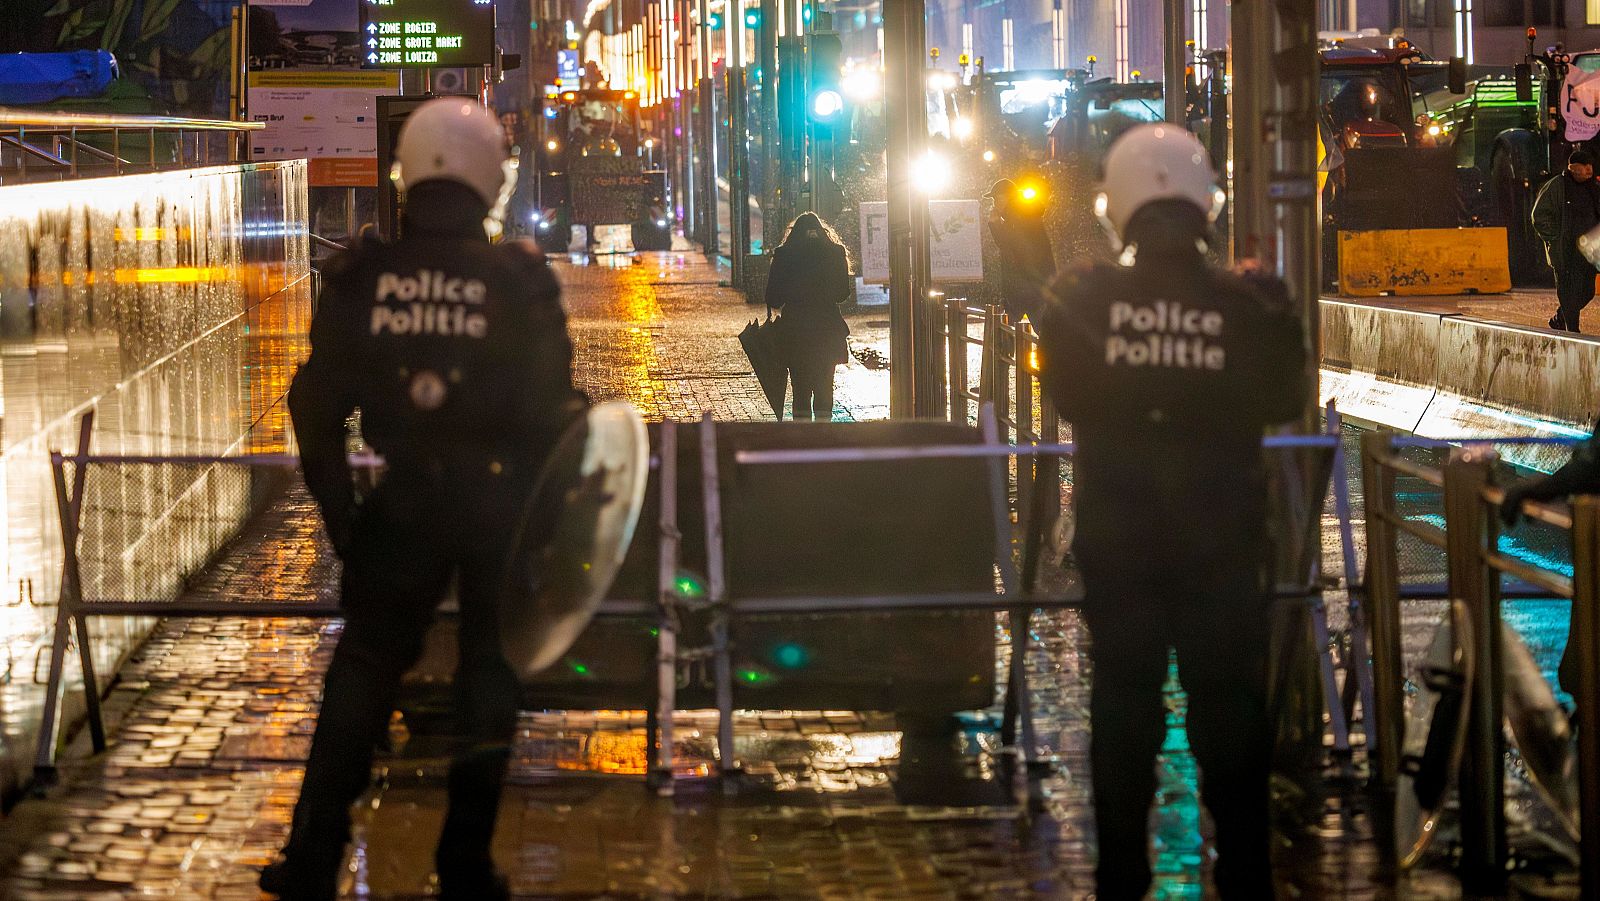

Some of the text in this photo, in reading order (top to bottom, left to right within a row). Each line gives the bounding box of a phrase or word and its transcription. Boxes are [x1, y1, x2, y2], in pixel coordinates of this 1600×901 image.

[379, 22, 437, 34] ZONE ROGIER
[379, 36, 463, 48] ZONE GROTE MARKT
[380, 51, 438, 63] ZONE LOUIZA
[376, 269, 487, 305] Police
[370, 305, 488, 339] Politie
[1109, 300, 1224, 336] Police
[1106, 335, 1226, 371] Politie
